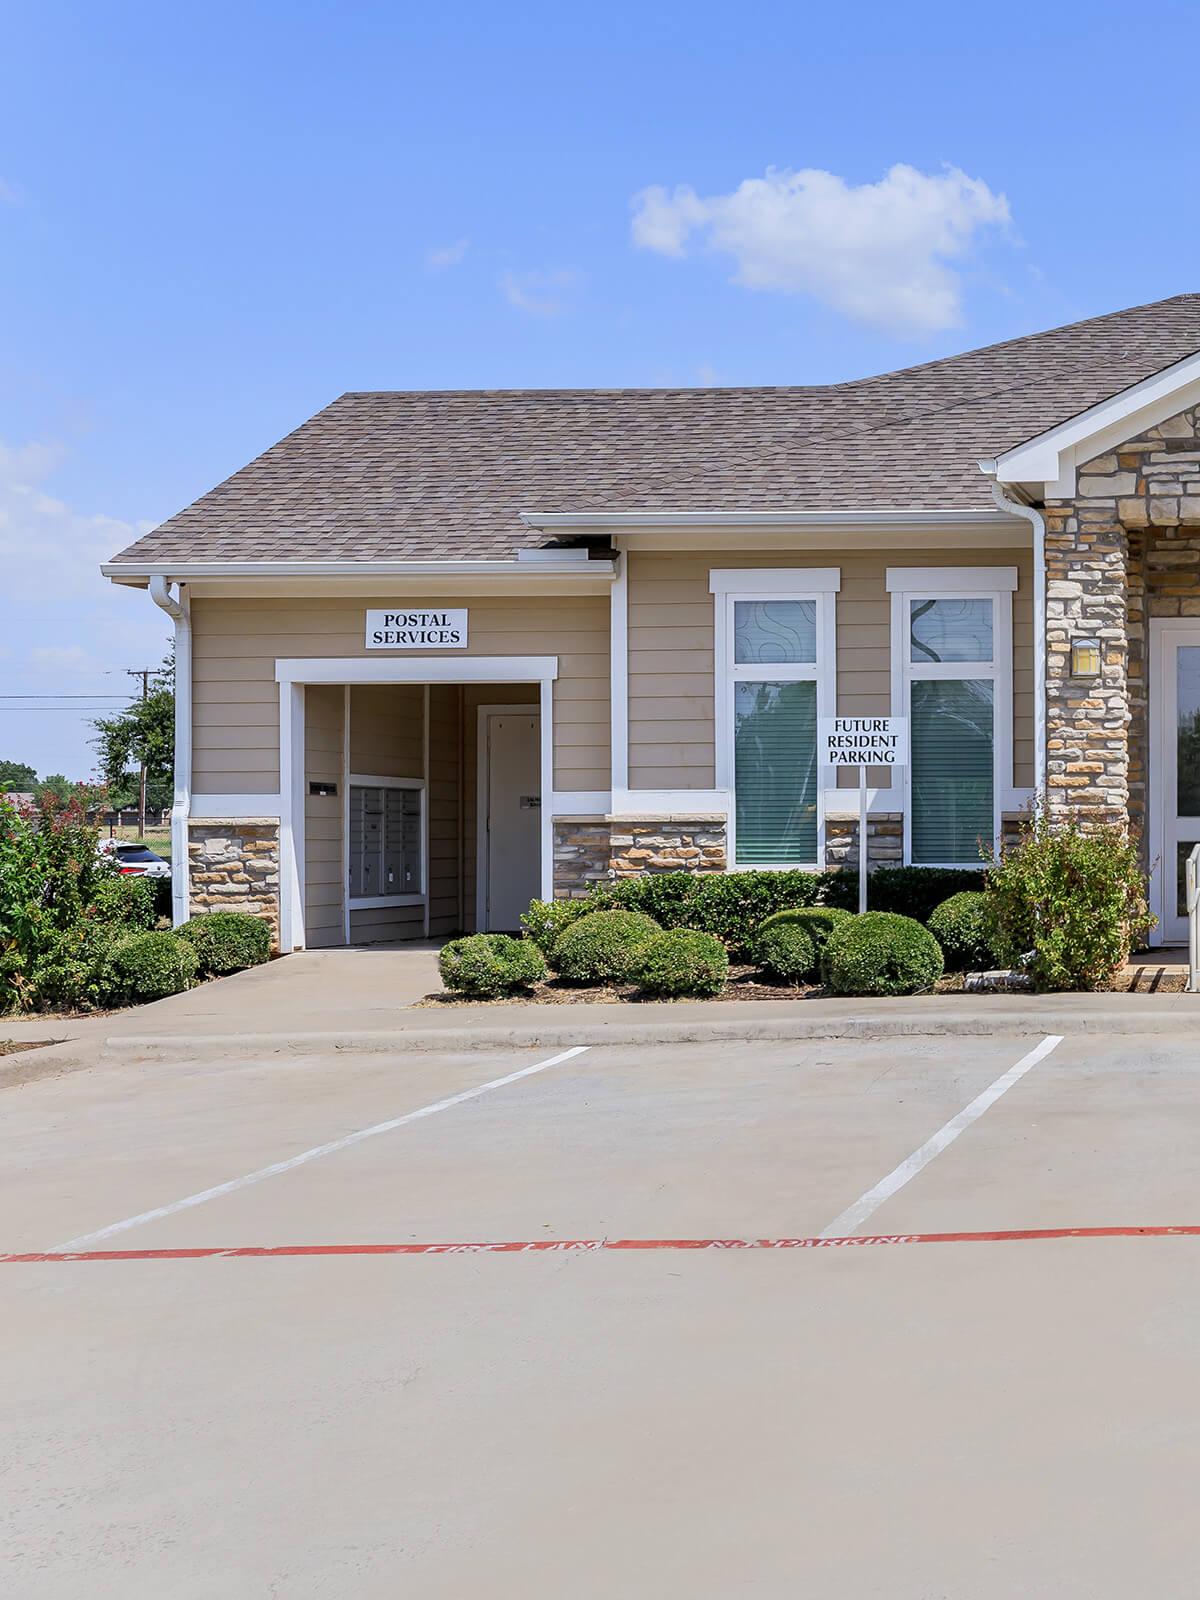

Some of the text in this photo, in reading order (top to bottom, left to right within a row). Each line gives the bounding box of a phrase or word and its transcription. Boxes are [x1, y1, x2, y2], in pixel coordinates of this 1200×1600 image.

[384, 614, 451, 627] POSTAL
[373, 631, 460, 643] SERVICES
[835, 720, 889, 732] FUTURE
[828, 736, 898, 747] RESIDENT
[830, 751, 895, 763] PARKING
